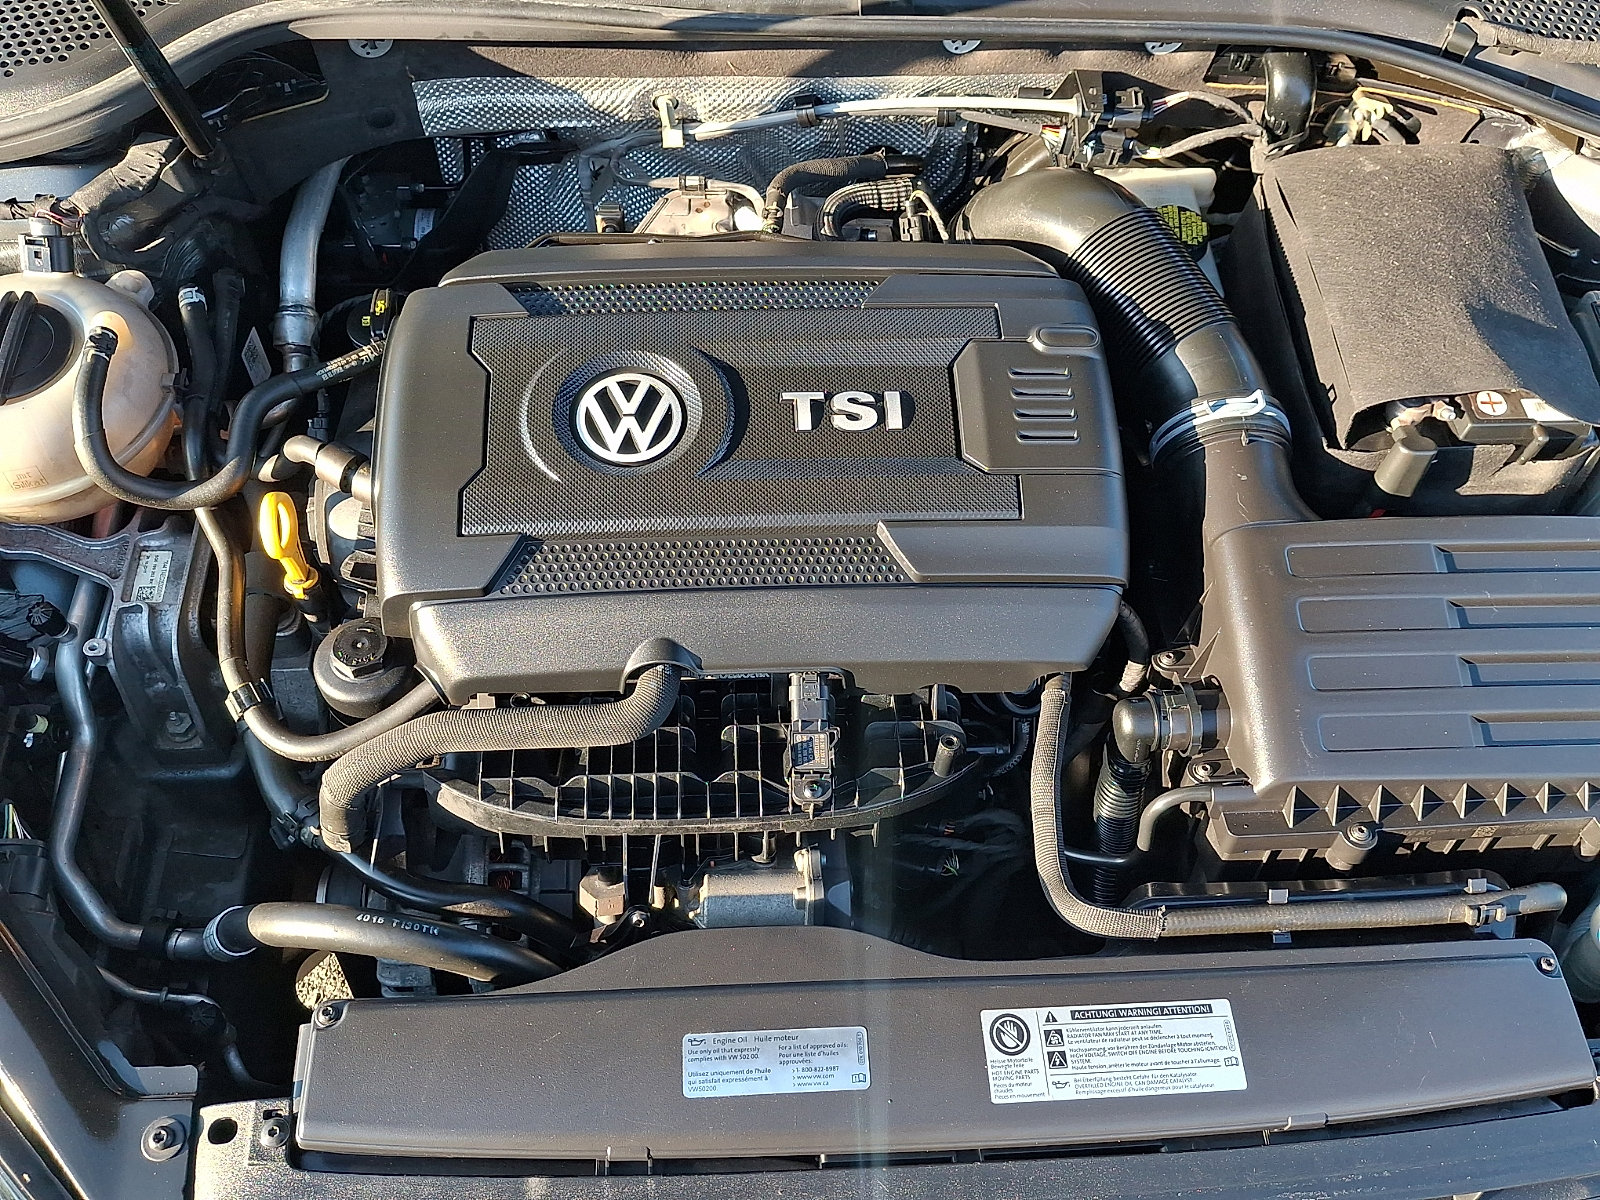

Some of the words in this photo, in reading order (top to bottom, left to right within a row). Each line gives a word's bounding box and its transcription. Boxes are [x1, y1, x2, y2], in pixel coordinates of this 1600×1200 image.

[780, 390, 904, 432] TSI
[16, 472, 31, 480] mit
[12, 478, 46, 490] Silikat
[1075, 1010, 1117, 1019] ACHTUNG!
[1119, 1008, 1161, 1016] WARNING!
[1163, 1005, 1210, 1014] ATTENTION!
[713, 1038, 736, 1046] Engine
